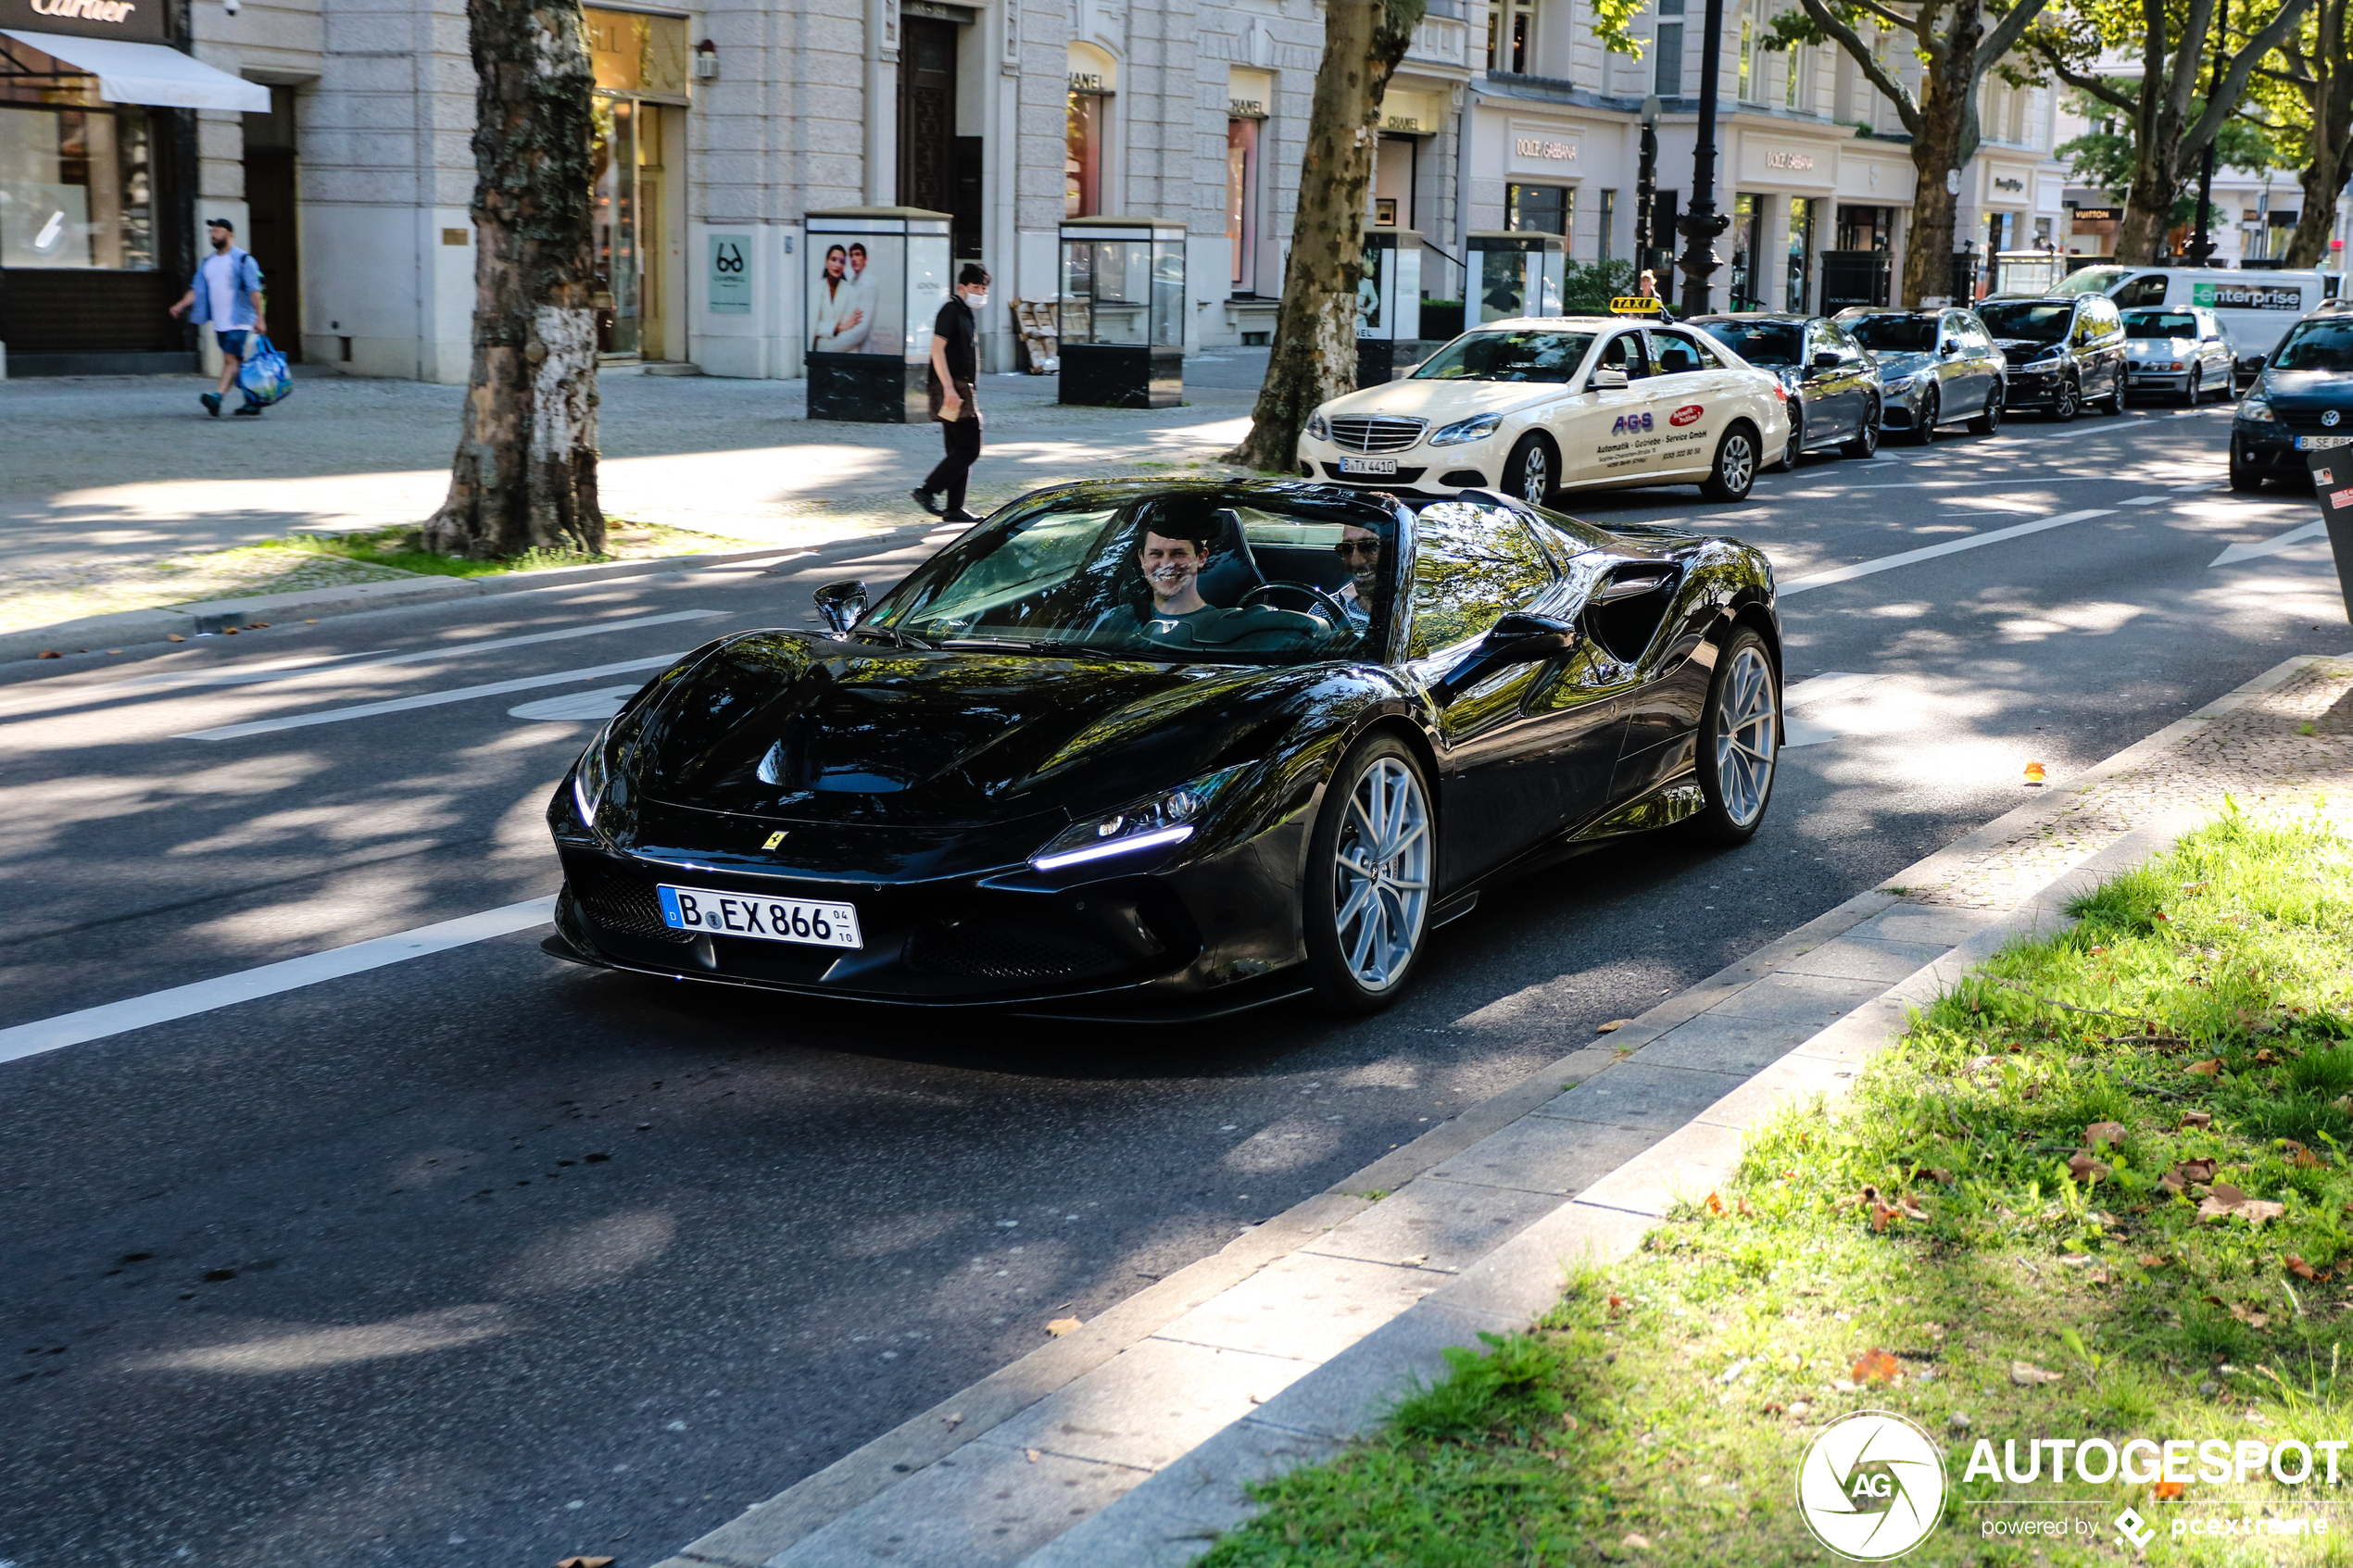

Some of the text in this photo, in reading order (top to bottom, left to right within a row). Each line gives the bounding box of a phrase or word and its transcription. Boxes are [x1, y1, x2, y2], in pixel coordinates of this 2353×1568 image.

[2199, 288, 2300, 307] enterprise
[1617, 299, 1647, 308] TAXI
[1596, 430, 1706, 453] Automatik Getriebe Service GmbH
[2301, 438, 2309, 447] B
[2316, 437, 2330, 447] SE
[1344, 459, 1394, 472] B TX 4410
[670, 911, 677, 921] D
[678, 894, 831, 940] B EX 866
[833, 909, 849, 920] 04
[839, 932, 852, 943] 10
